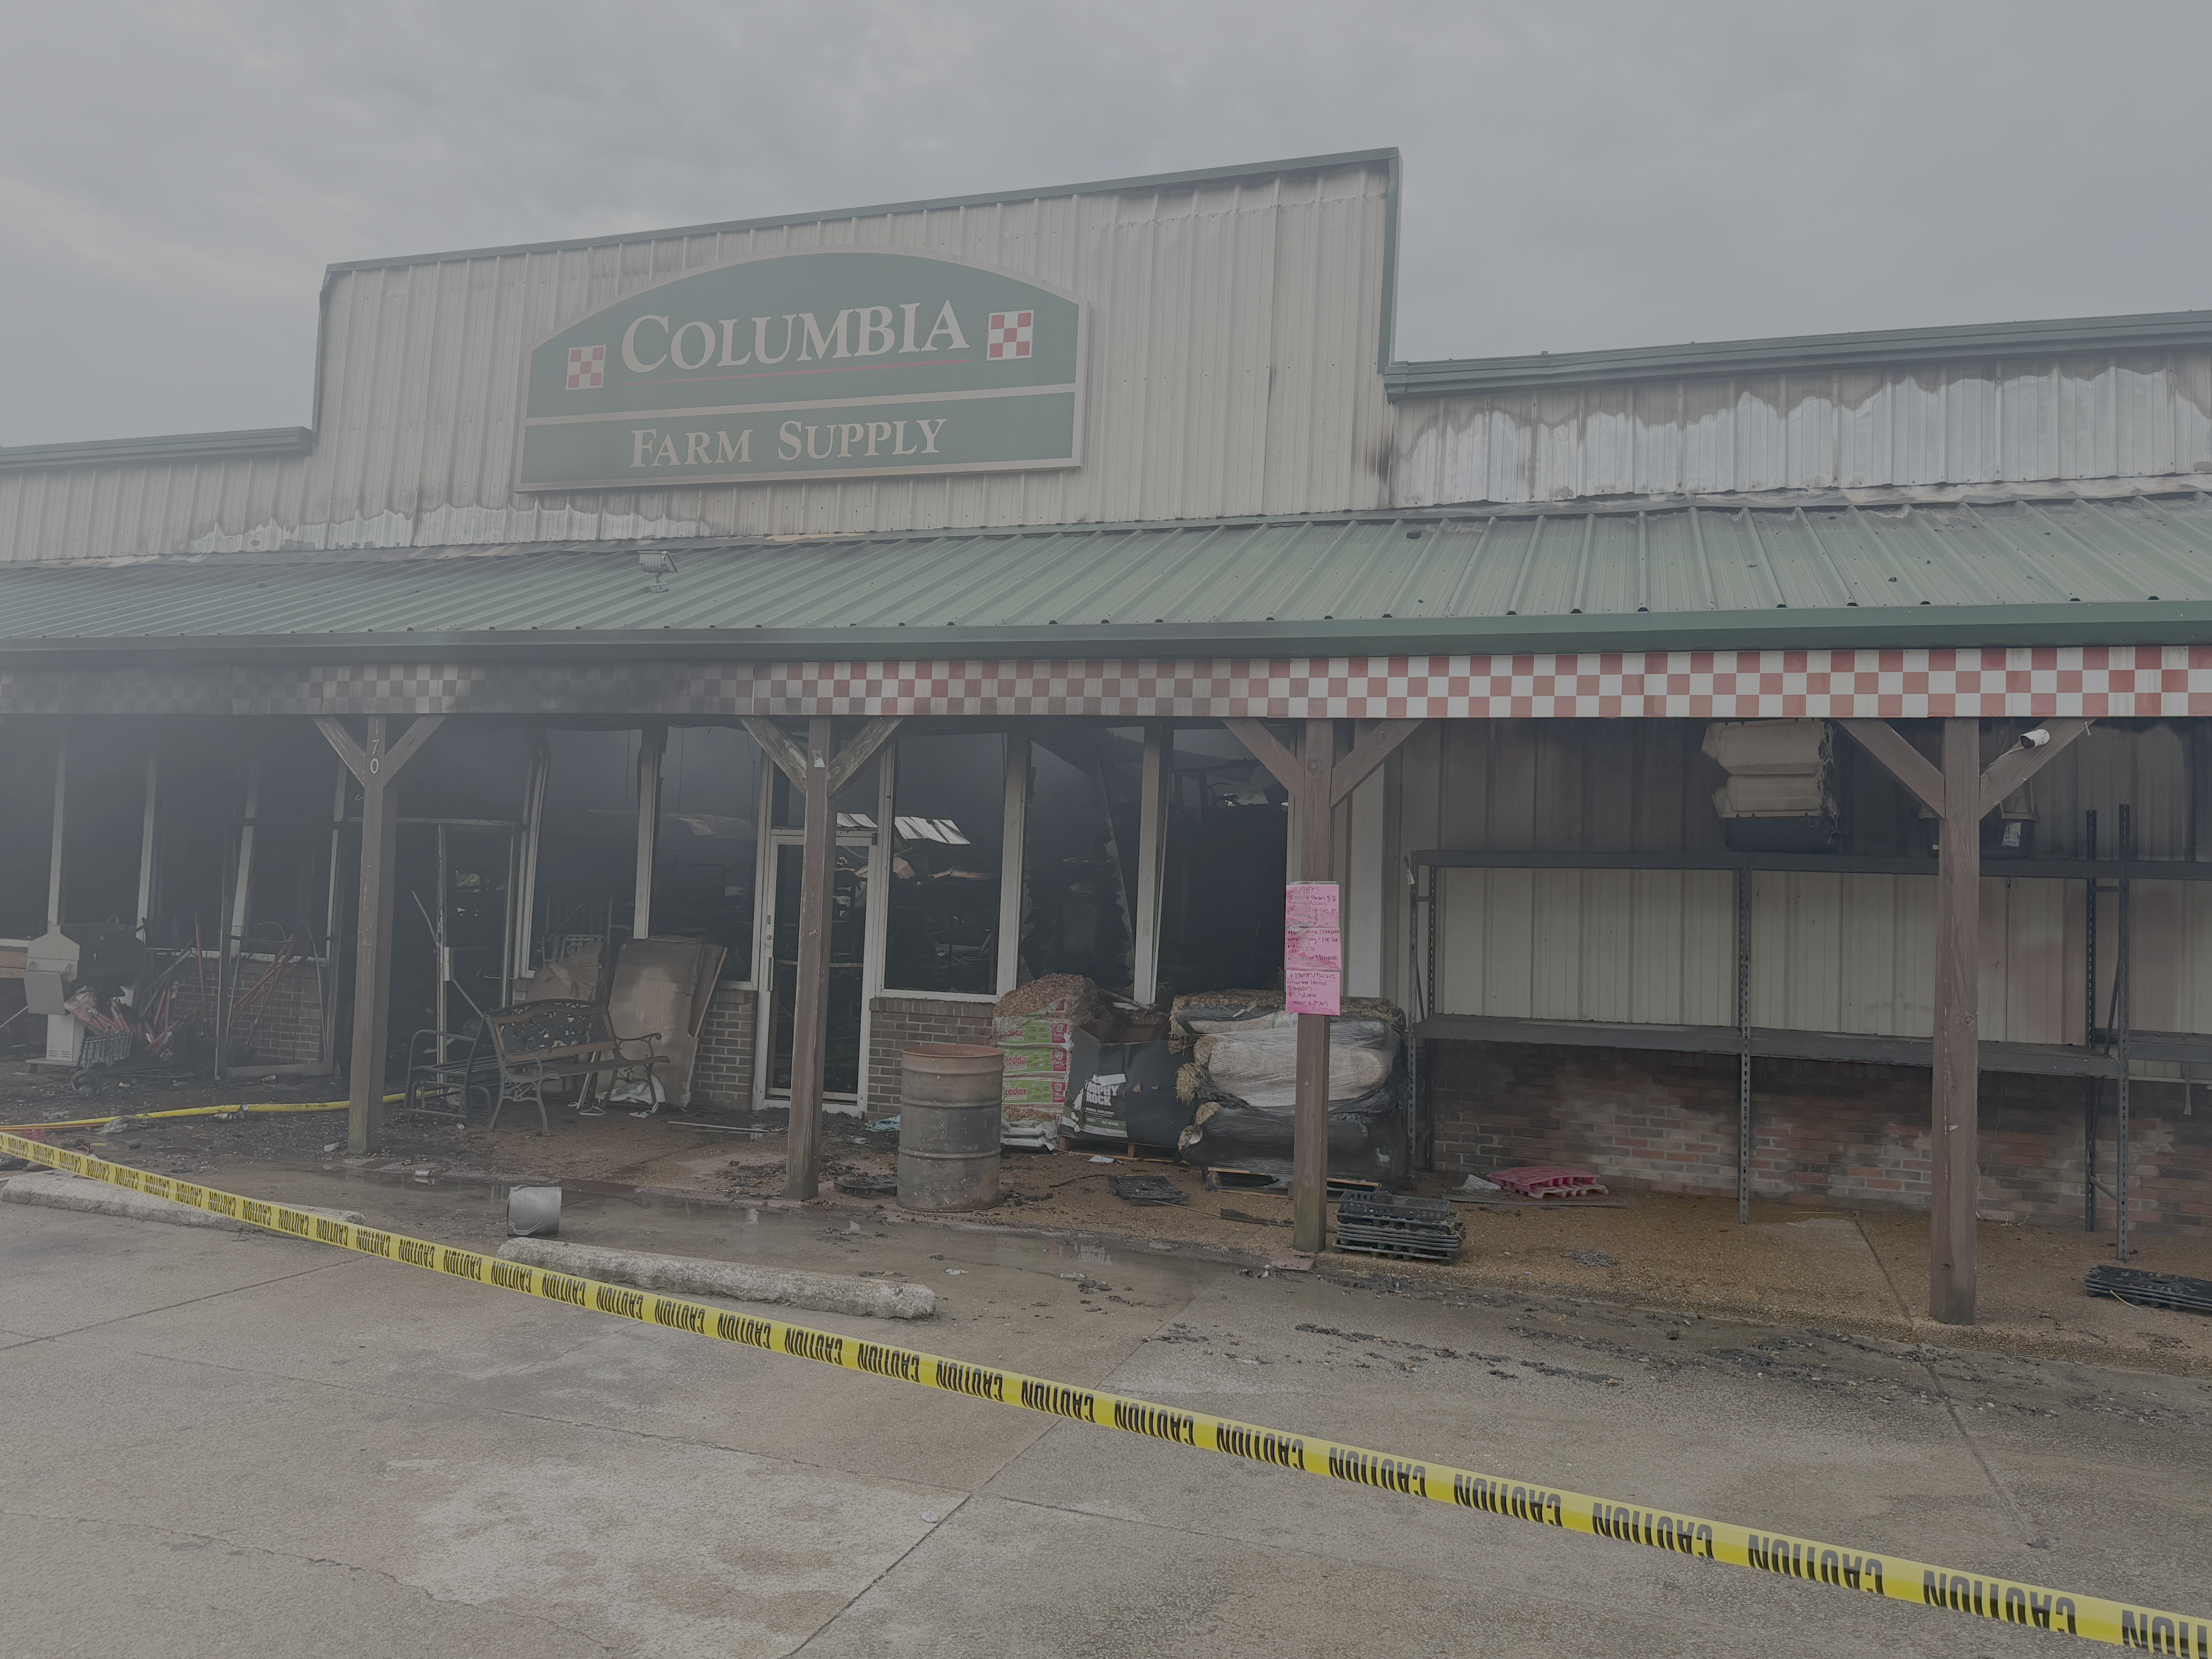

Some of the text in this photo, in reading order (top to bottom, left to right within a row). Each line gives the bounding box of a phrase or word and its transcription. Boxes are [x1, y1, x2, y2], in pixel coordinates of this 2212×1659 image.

[621, 299, 970, 374] COLUMBIA
[629, 418, 946, 467] FARM SUPPLY
[370, 719, 380, 774] 170
[1006, 1053, 1027, 1066] cedar
[1005, 1086, 1027, 1096] cedar
[1085, 1080, 1119, 1096] ROPHY
[1086, 1091, 1112, 1106] ROCK
[9, 1137, 28, 1158] CAUTION
[34, 1144, 54, 1164] CAUTION
[60, 1151, 81, 1171] CAUTION
[87, 1159, 109, 1179] CAUTION
[115, 1166, 139, 1187] CAUTION
[144, 1175, 170, 1195] CAUTION
[176, 1183, 202, 1205] CAUTION
[208, 1191, 236, 1214] CAUTION
[243, 1200, 271, 1225] CAUTION
[279, 1209, 309, 1236] CAUTION
[317, 1219, 348, 1246] CAUTION
[357, 1229, 390, 1257] CAUTION
[399, 1239, 434, 1269] CAUTION
[444, 1250, 481, 1281] CAUTION
[491, 1261, 532, 1293] CAUTION
[543, 1273, 586, 1306] CAUTION
[597, 1286, 643, 1319] CAUTION
[655, 1300, 705, 1334] CAUTION
[718, 1313, 771, 1349] CAUTION
[785, 1328, 842, 1365] CAUTION
[858, 1343, 919, 1382] CAUTION
[936, 1361, 1002, 1400] CAUTION
[1022, 1379, 1093, 1421] CAUTION
[1115, 1400, 1193, 1444] CAUTION
[1217, 1422, 1304, 1470] CAUTION
[1329, 1448, 1425, 1498] CAUTION
[1454, 1474, 1561, 1527] CAUTION
[1593, 1503, 1712, 1559] CAUTION
[1748, 1535, 1883, 1595] CAUTION
[1924, 1569, 2076, 1635] CAUTION
